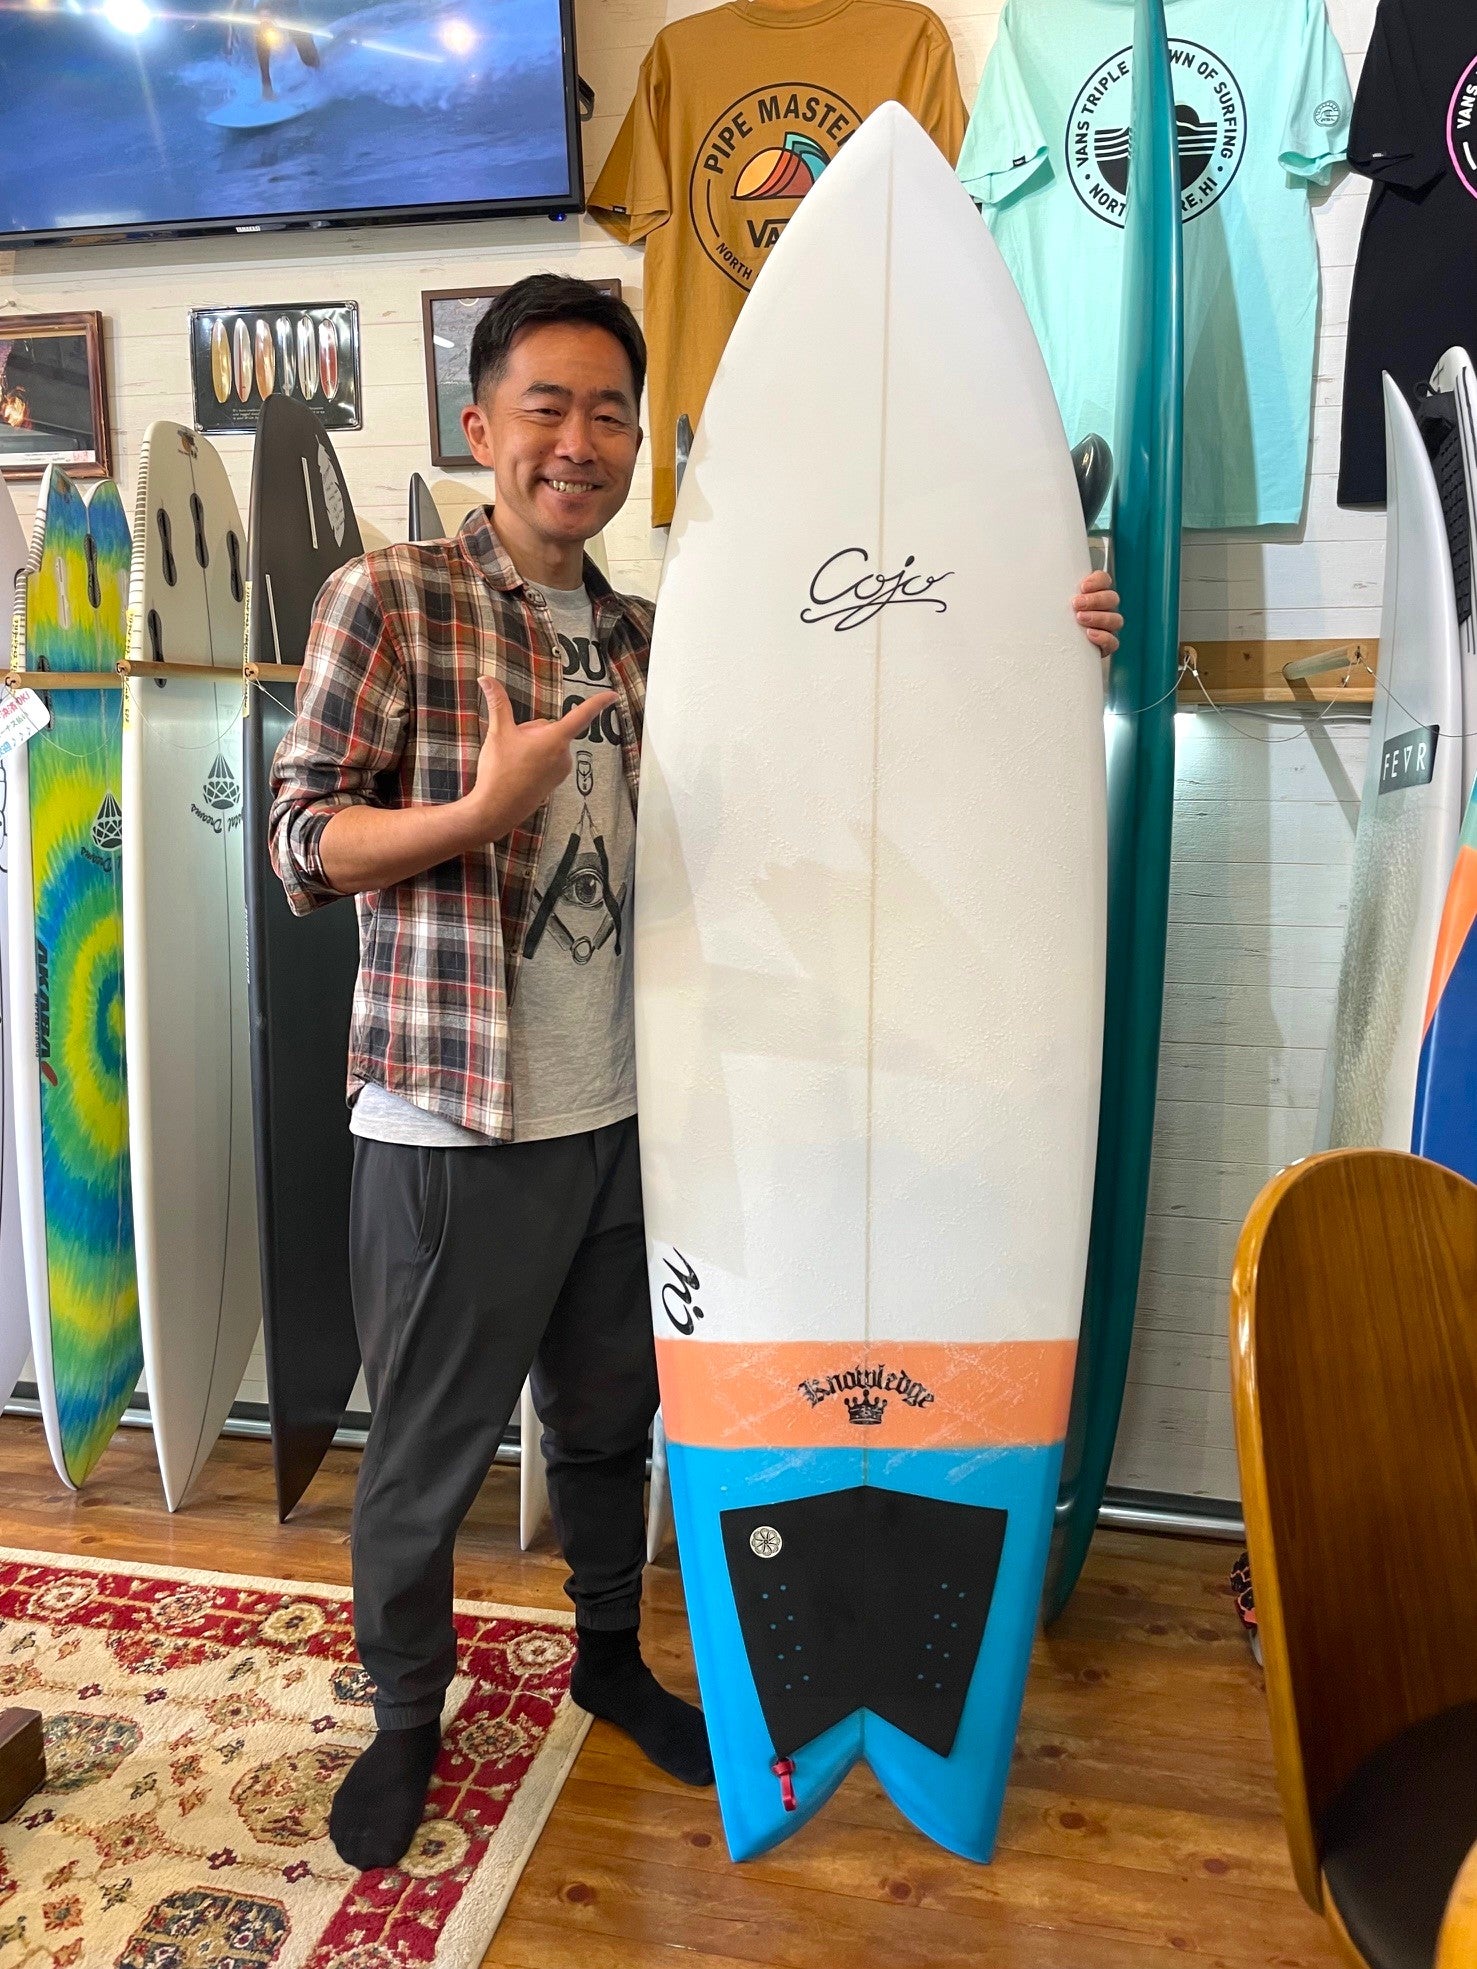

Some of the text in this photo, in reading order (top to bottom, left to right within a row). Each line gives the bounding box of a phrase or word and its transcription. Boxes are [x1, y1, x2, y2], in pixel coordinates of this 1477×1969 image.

[1081, 60, 1130, 115] TRIPLE
[1197, 61, 1219, 80] OF
[1213, 81, 1238, 160] SURFING
[1457, 83, 1477, 129] VANS
[703, 112, 754, 174] PIPE
[1075, 120, 1090, 168] VANS
[1198, 176, 1219, 198] HI
[716, 242, 753, 281] NORTH
[800, 547, 955, 632] Cojo
[191, 803, 222, 834] Dreams
[798, 1364, 935, 1408] Knowledge
